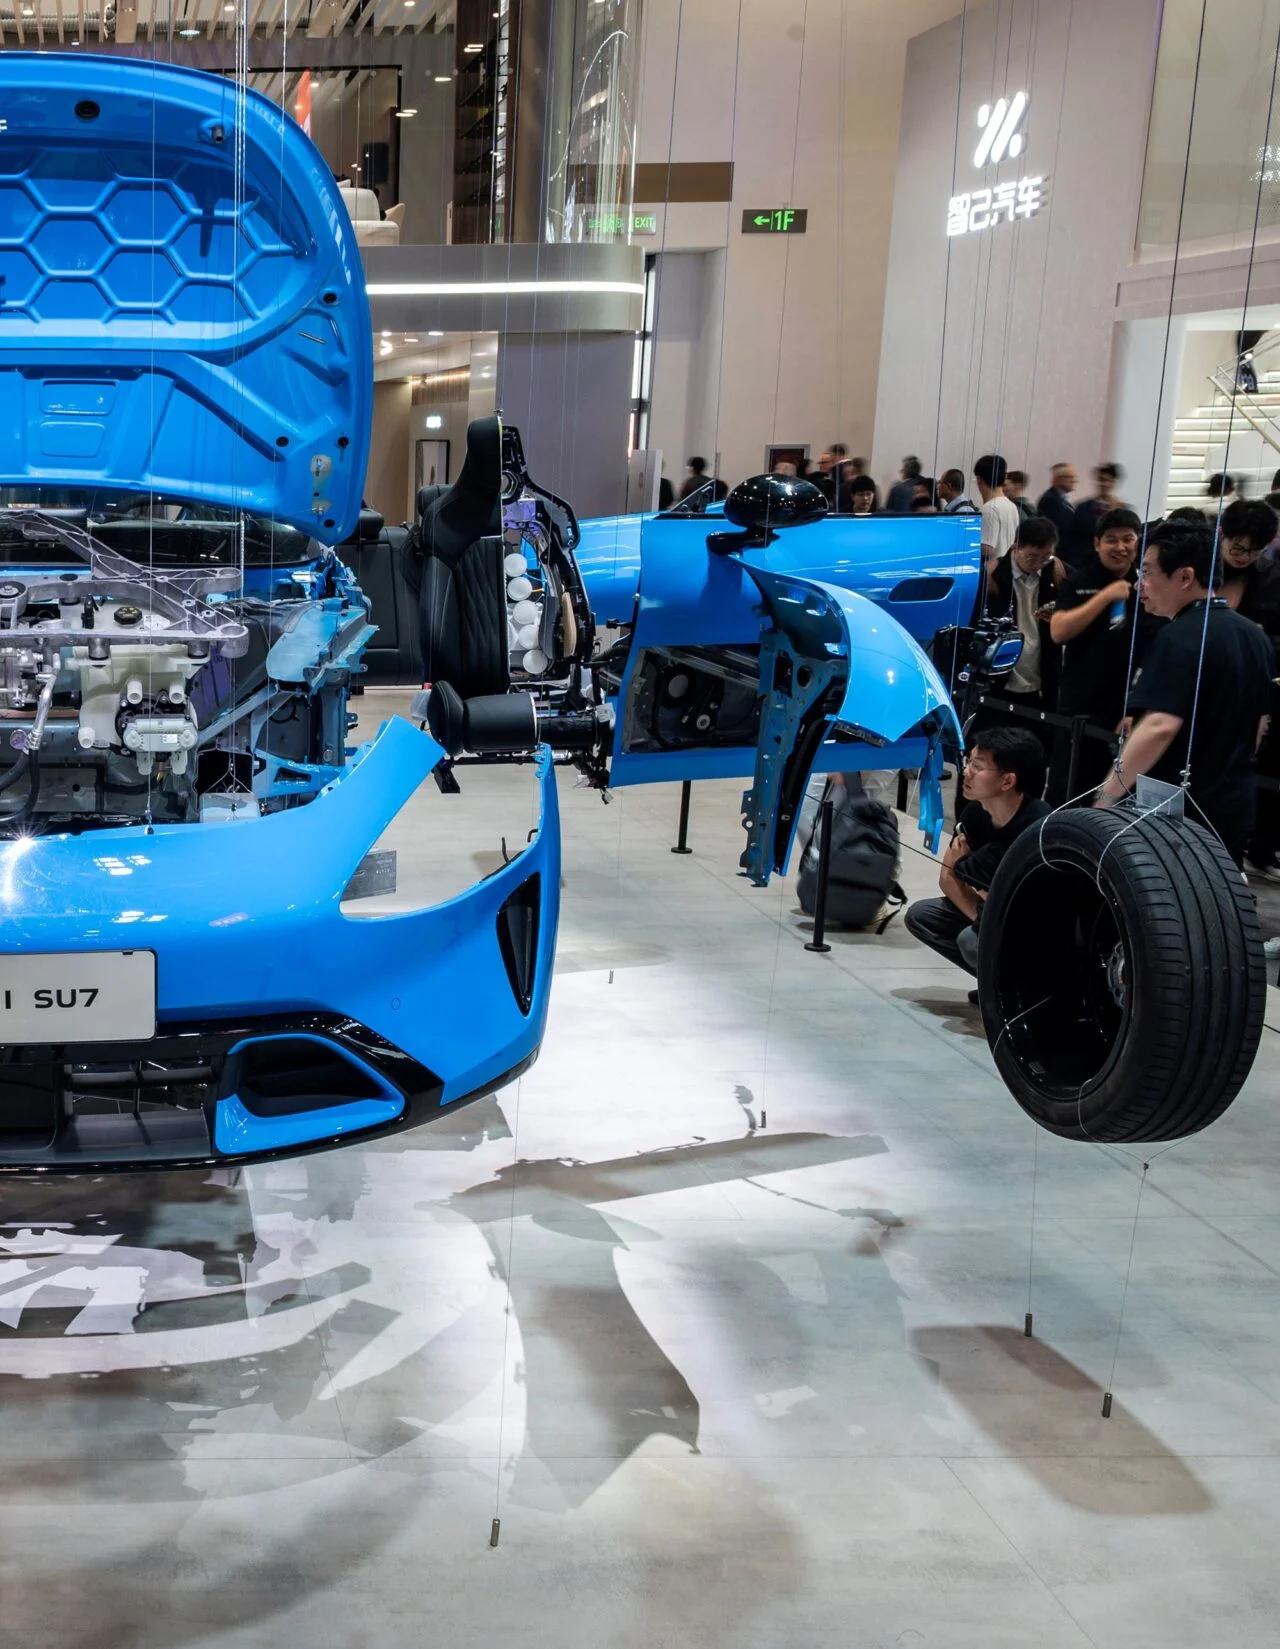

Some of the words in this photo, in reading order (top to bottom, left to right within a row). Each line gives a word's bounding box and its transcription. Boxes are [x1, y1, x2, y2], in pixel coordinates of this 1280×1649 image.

[946, 176, 1043, 236] 智己汽车
[634, 216, 653, 228] EXIT
[774, 210, 795, 231] 1F
[34, 988, 99, 1009] SU7
